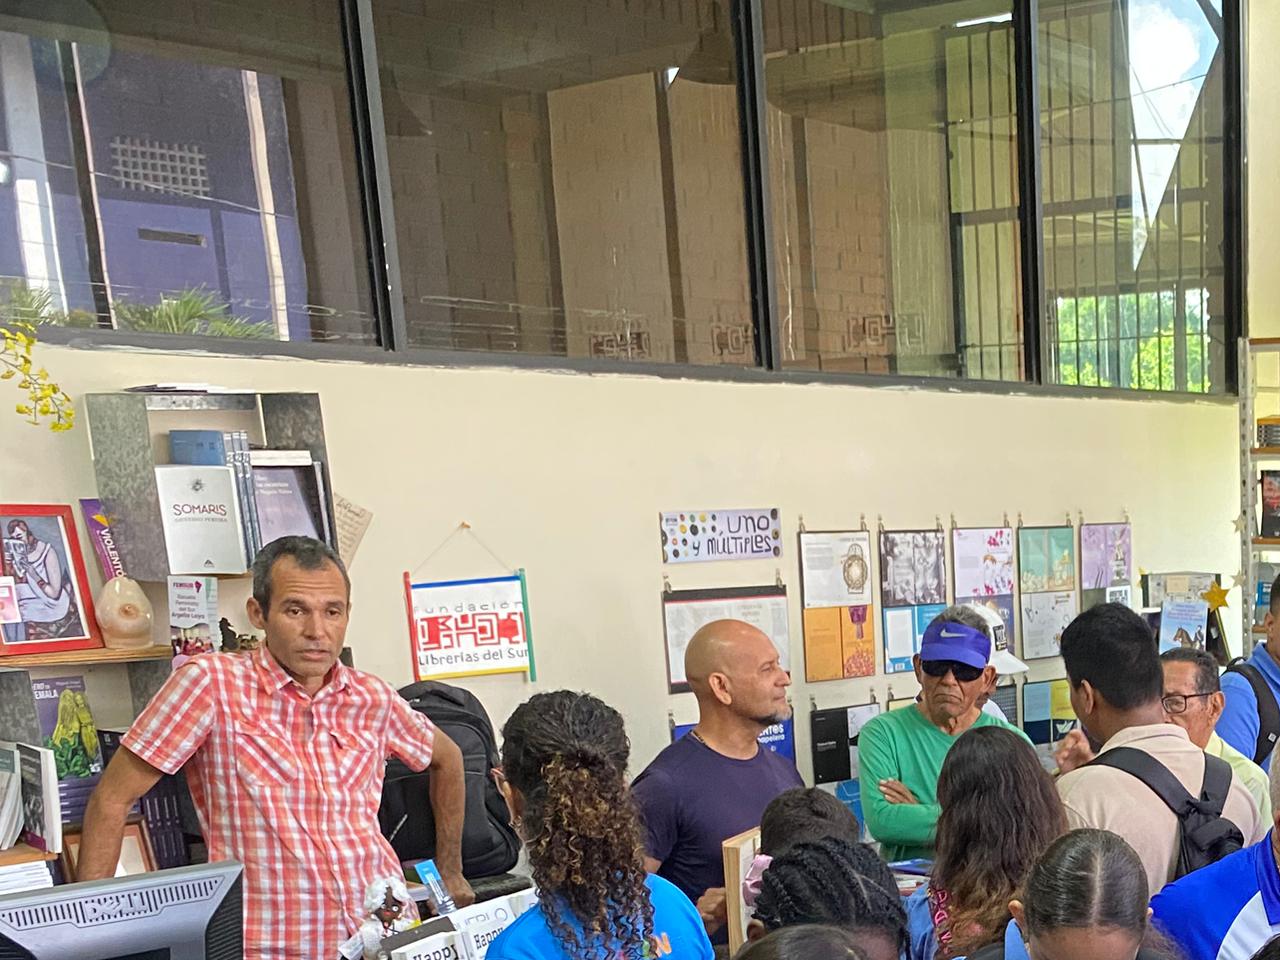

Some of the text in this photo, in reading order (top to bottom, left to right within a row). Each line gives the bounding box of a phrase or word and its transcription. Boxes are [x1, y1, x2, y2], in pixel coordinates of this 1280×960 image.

[172, 503, 227, 516] SOMARIS
[482, 649, 503, 661] del
[507, 648, 529, 659] Sur
